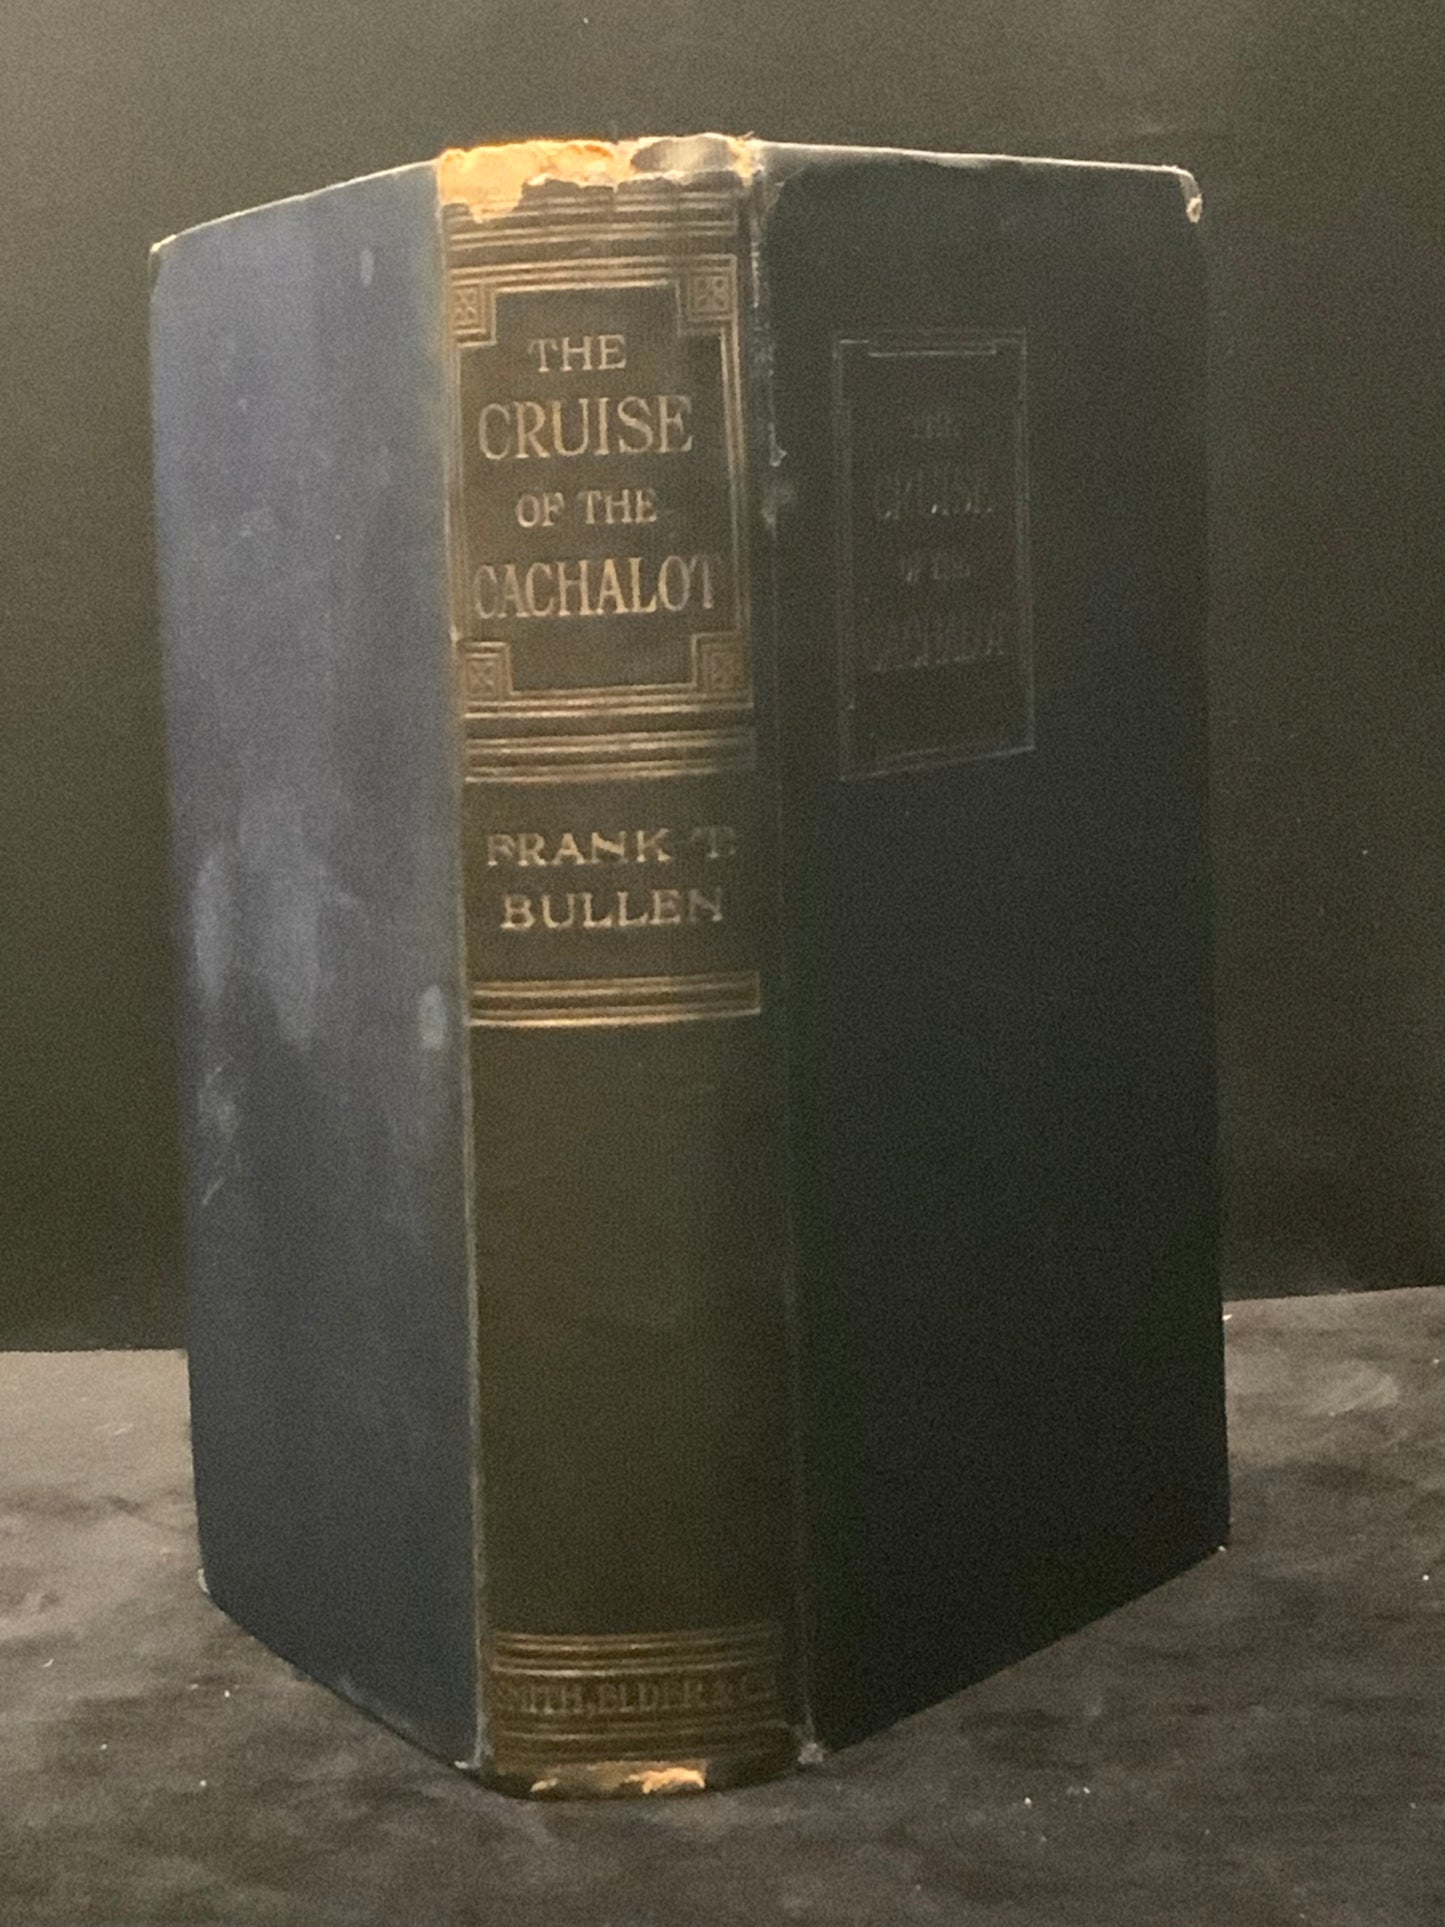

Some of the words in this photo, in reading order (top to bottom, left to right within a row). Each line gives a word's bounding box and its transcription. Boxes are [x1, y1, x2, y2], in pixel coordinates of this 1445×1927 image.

[528, 334, 627, 373] THE
[478, 394, 694, 460] CRUISE
[514, 491, 565, 528] OF
[577, 488, 659, 525] THE
[472, 555, 718, 619] CACHALOT
[487, 827, 673, 866] FRANK
[501, 886, 724, 929] BULLEN
[496, 1681, 596, 1716] ITH,
